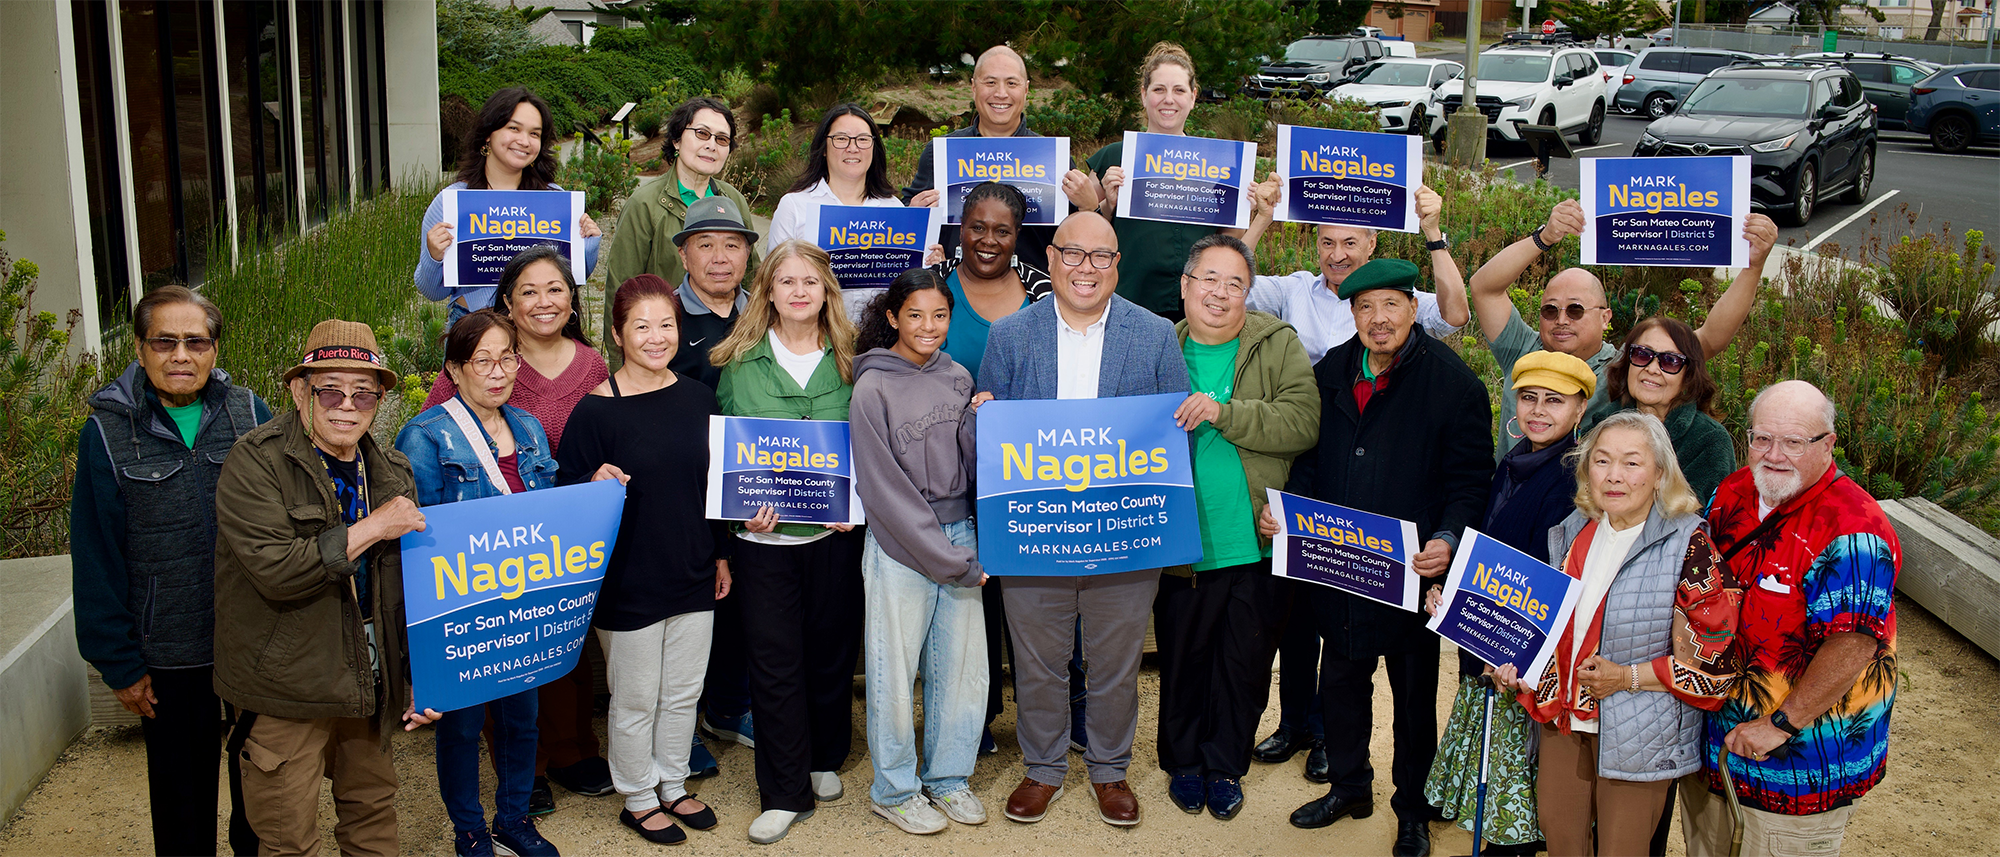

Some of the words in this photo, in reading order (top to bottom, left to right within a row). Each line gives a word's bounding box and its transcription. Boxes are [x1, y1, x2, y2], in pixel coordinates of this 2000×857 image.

[976, 152, 1012, 161] MARK
[1164, 149, 1200, 161] MARK
[1320, 145, 1359, 157] MARK
[958, 158, 1046, 182] Nagales
[1145, 154, 1231, 180] Nagales
[1301, 150, 1395, 180] Nagales
[1176, 184, 1199, 192] Mateo
[1200, 186, 1226, 196] County
[1319, 182, 1334, 190] San
[1336, 184, 1361, 192] Mateo
[1363, 186, 1392, 196] County
[1631, 176, 1676, 187] MARK
[1145, 191, 1184, 200] Supervisor
[1191, 195, 1218, 203] District
[1303, 191, 1347, 201] Supervisor
[1354, 195, 1384, 204] District
[1609, 183, 1719, 214] Nagales
[489, 207, 528, 216] MARK
[1149, 202, 1219, 214] MARKNAGALES.COM
[1308, 204, 1386, 215] MARKNAGALES.COM
[470, 214, 561, 240] Nagales
[849, 221, 886, 230] MARK
[1682, 219, 1715, 228] County
[830, 227, 916, 250] Nagales
[1612, 230, 1662, 240] Supervisor
[1671, 230, 1705, 239] District
[1709, 230, 1715, 238] 5
[472, 254, 514, 263] Superviso
[830, 262, 869, 270] Supervisor
[318, 349, 349, 359] Puerto
[351, 349, 369, 360] Rico
[453, 407, 480, 441] GUESS
[758, 436, 800, 448] MARK
[1038, 427, 1113, 447] MARK
[480, 449, 503, 485] GUESS
[737, 442, 839, 472] Nagales
[1001, 439, 1168, 492] Nagales
[739, 475, 754, 483] For
[756, 476, 773, 484] San
[775, 477, 802, 486] Mateo
[805, 478, 835, 488] County
[738, 487, 786, 496] Supervisor
[794, 489, 826, 497] District
[829, 490, 835, 498] 5
[744, 500, 829, 510] MARKNAGALES.COM
[1008, 501, 1033, 513] For
[1038, 501, 1067, 513] San
[1072, 500, 1118, 513] Mateo
[1121, 494, 1166, 509] County
[1008, 520, 1093, 536] Supervisor
[1107, 514, 1154, 530] District
[1158, 512, 1168, 524] 5
[1314, 512, 1354, 529] MARK
[469, 523, 545, 554] MARK
[1295, 513, 1393, 552] Nagales
[1019, 536, 1162, 554] MARKNAGALES.COM
[1302, 540, 1315, 549] For
[1317, 544, 1332, 554] San
[1335, 548, 1360, 560] Mateo
[1362, 555, 1391, 569] County
[431, 535, 606, 600] Nagales
[1302, 550, 1345, 566] Supervisor
[1353, 563, 1382, 576] District
[1385, 571, 1390, 579] 5
[1307, 563, 1385, 588] MARKNAGALES.COM
[1494, 563, 1529, 588] MARK
[1472, 562, 1550, 621] Nagales
[444, 622, 471, 637] For
[475, 615, 505, 631] San
[510, 605, 555, 622] Mateo
[558, 590, 597, 612] County
[1466, 597, 1478, 608] For
[1478, 602, 1490, 615] San
[1491, 609, 1510, 625] Mateo
[1510, 621, 1535, 640] County
[445, 631, 531, 660] Supervisor
[544, 614, 586, 638] District
[587, 607, 593, 620] 5
[1460, 607, 1494, 630] Supervisor
[1496, 627, 1521, 646] District
[1521, 642, 1529, 650] 5
[1457, 622, 1516, 658] MARKNAGALES.COM
[459, 634, 585, 682] MARKNAGALES.COM
